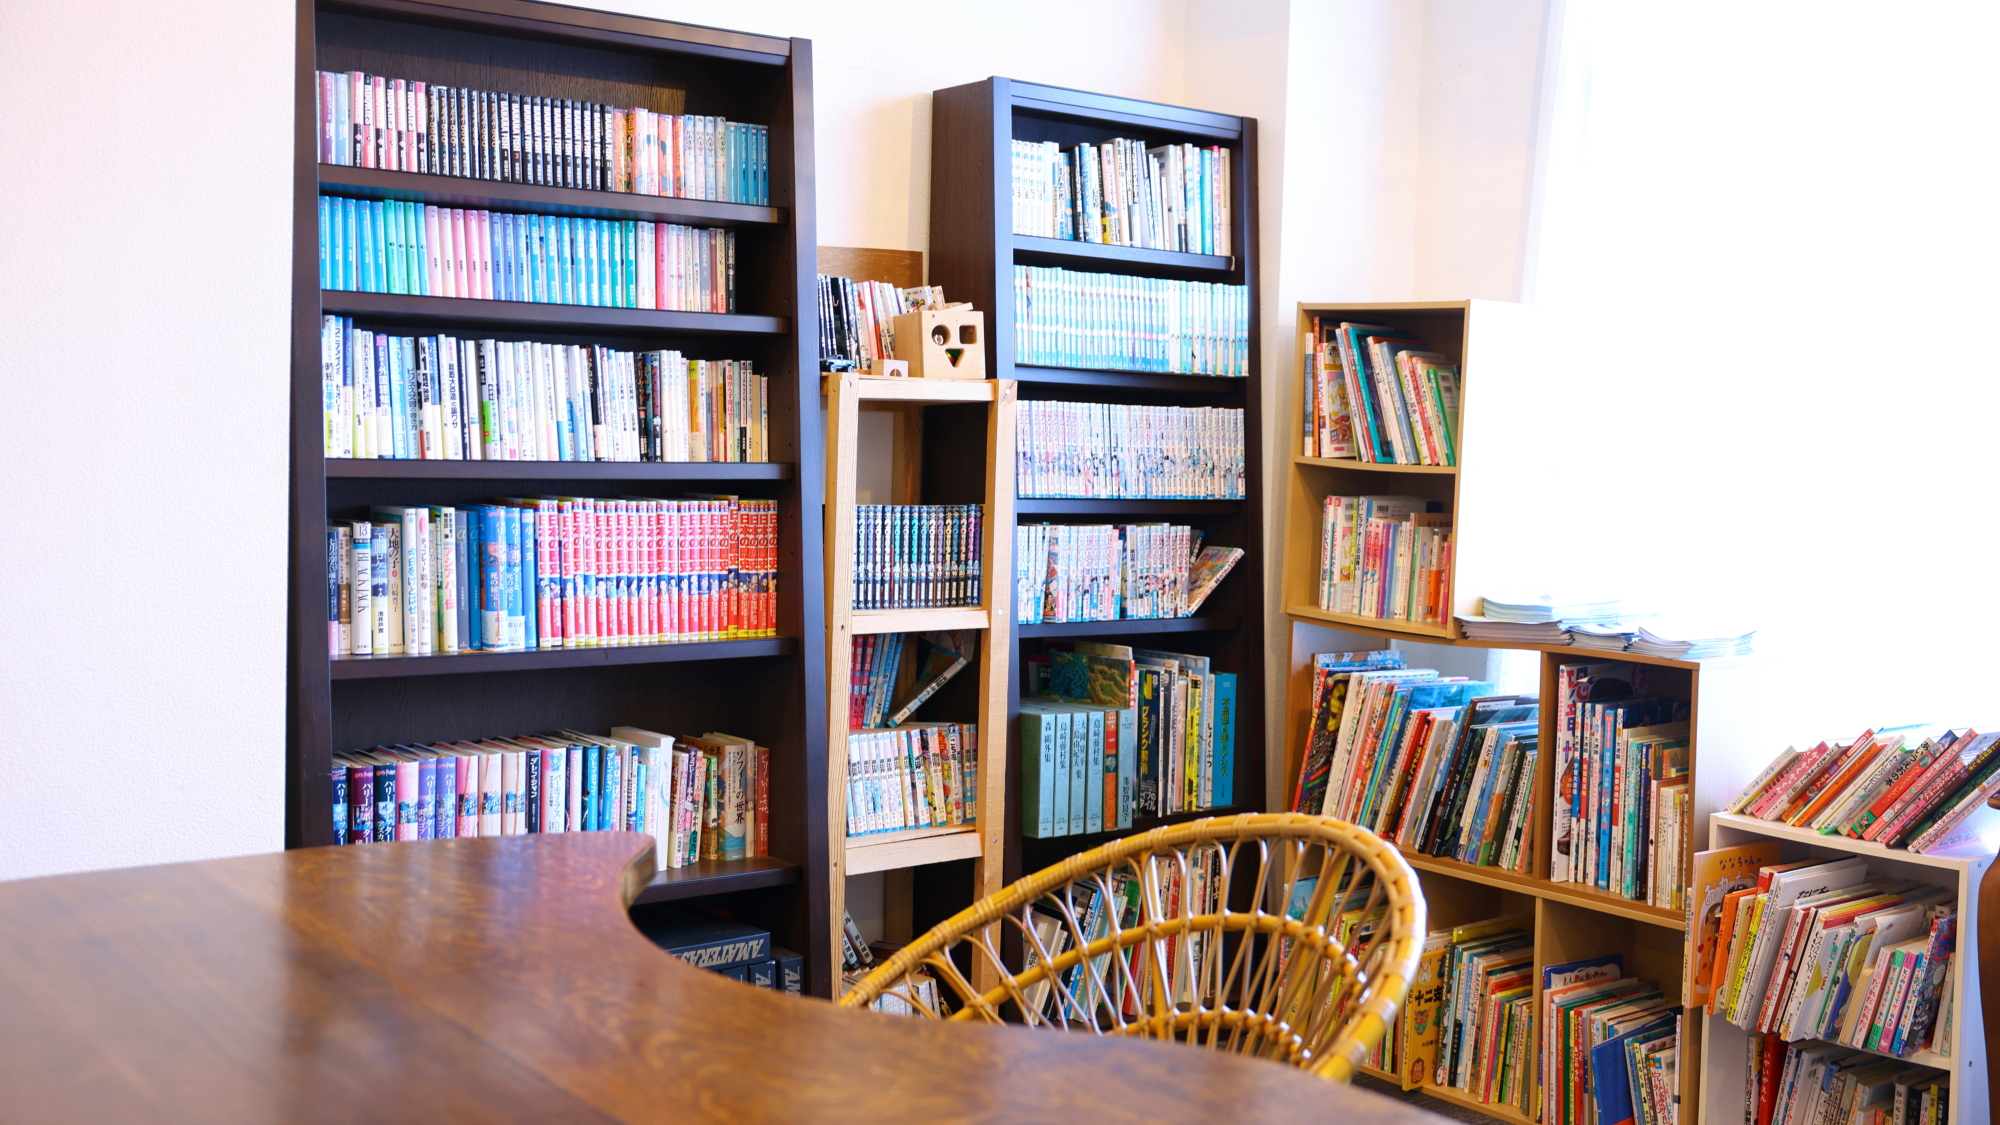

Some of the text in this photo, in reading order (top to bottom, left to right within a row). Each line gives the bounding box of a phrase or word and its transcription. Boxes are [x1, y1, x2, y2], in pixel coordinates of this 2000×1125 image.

[358, 525, 368, 537] 13
[388, 528, 400, 569] 大地の子
[525, 525, 534, 561] 小公女
[374, 532, 386, 586] 下町ロケット
[1220, 697, 1230, 777] 不思議の国のアリス
[1885, 740, 1931, 787] あいうえおの本
[735, 750, 745, 825] ソフィーの世界
[1719, 855, 1762, 871] ななちゃんの
[1760, 1051, 1771, 1103] いやいやえん
